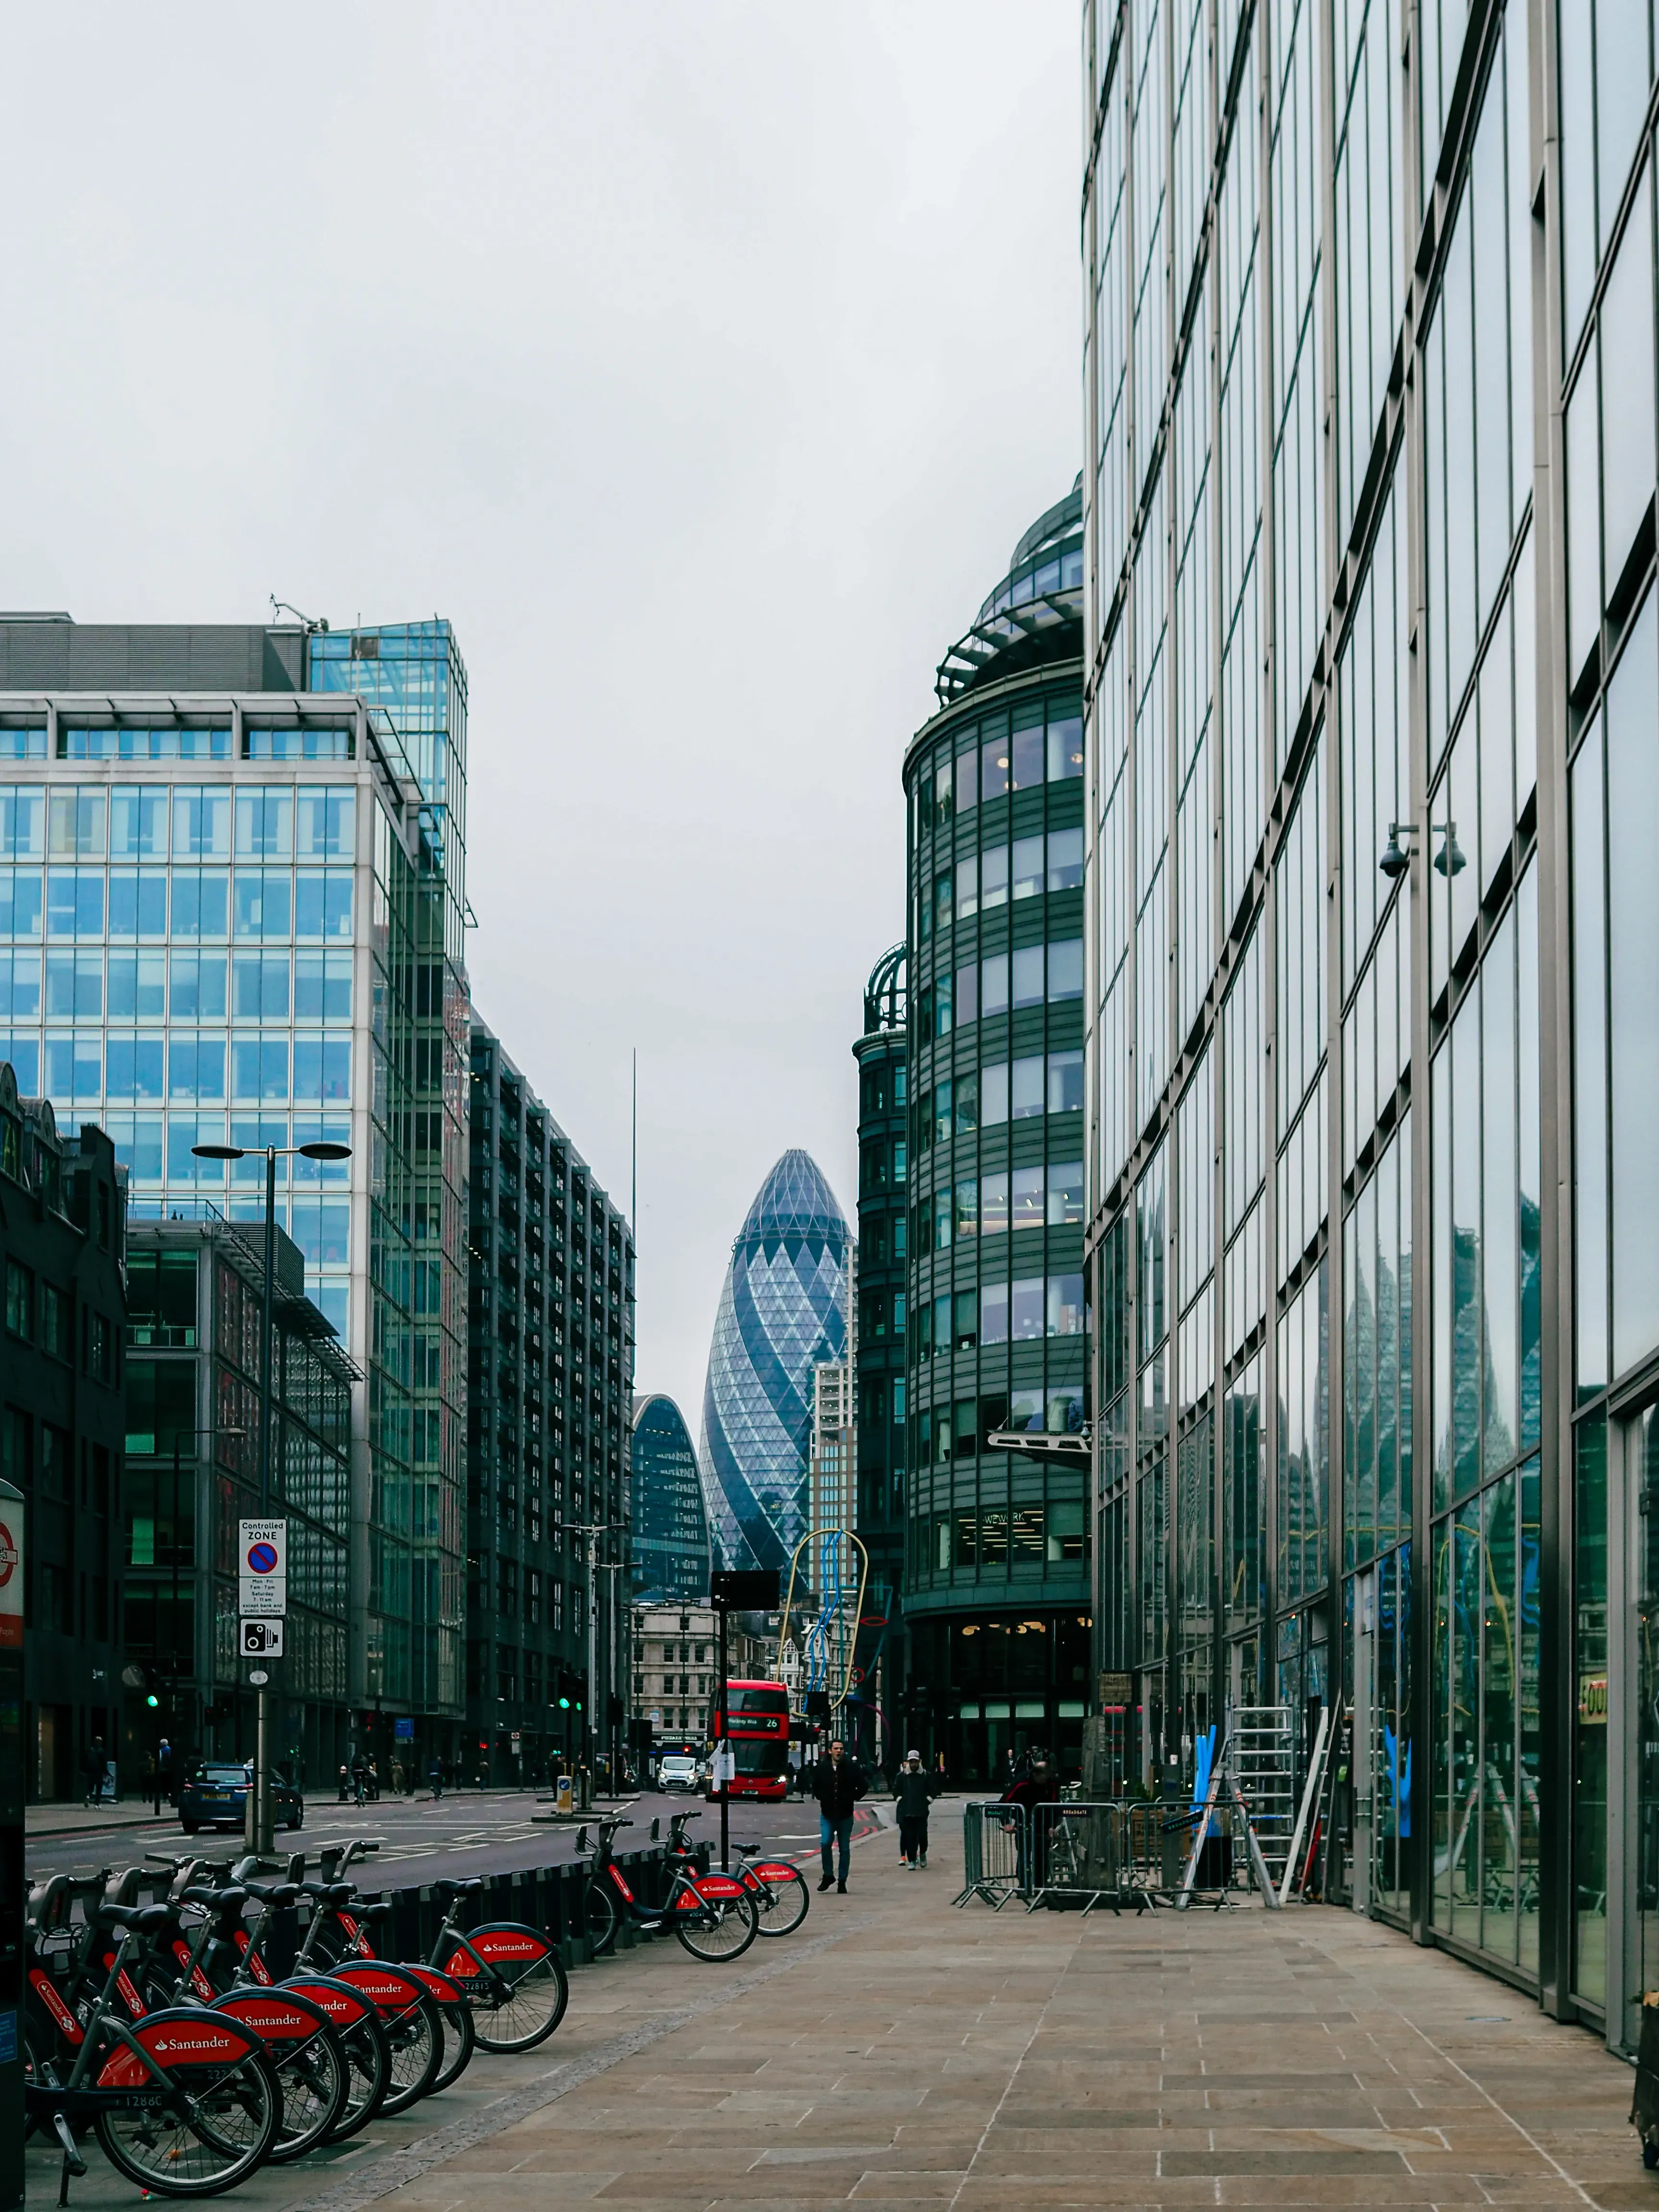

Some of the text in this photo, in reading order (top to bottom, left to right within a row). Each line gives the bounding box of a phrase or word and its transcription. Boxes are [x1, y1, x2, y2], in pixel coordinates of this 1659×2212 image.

[985, 1512, 1025, 1524] WEWRK
[248, 1531, 277, 1540] ZONE
[767, 1719, 777, 1728] 26
[492, 1942, 533, 1951] Santander
[318, 2000, 348, 2011] ander
[244, 2014, 301, 2026] Santander
[169, 2036, 229, 2050] Santander
